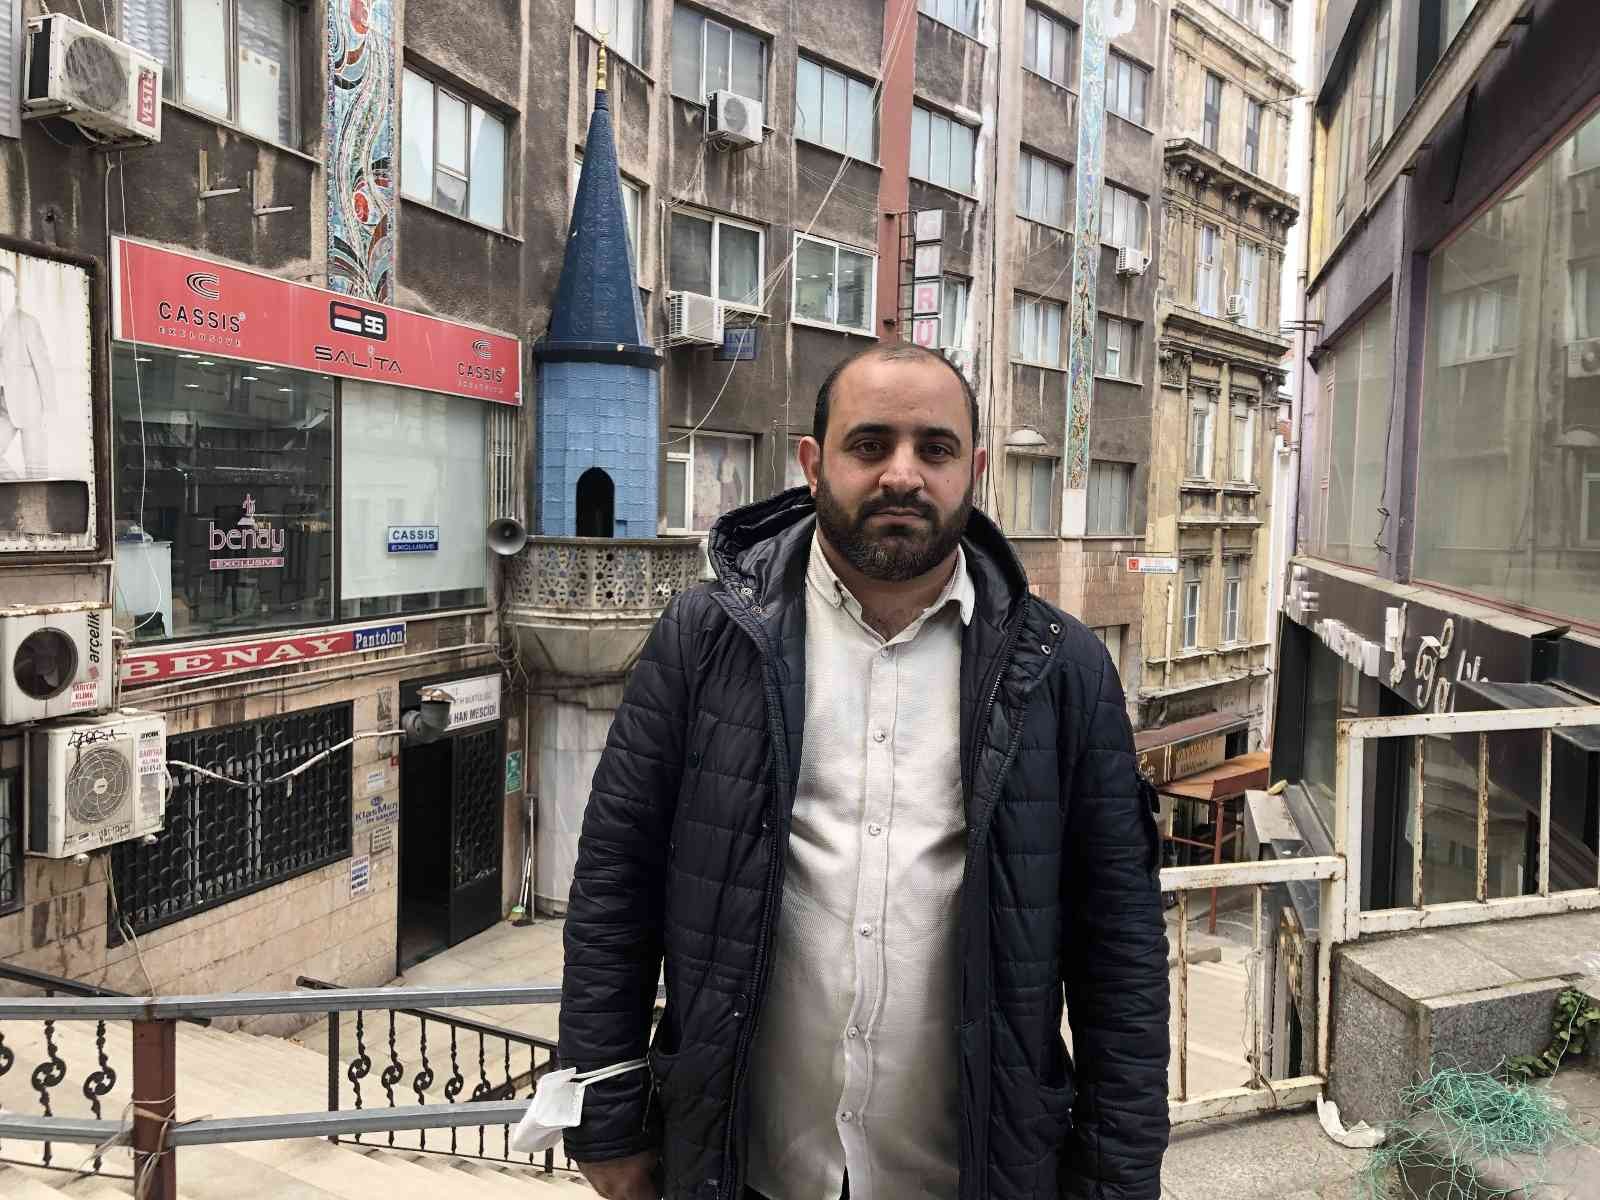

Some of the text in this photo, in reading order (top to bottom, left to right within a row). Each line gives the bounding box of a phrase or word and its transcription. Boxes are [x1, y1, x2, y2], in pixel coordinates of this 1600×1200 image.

[158, 301, 241, 333] CASSIS
[457, 362, 503, 383] CASSIS
[392, 530, 435, 540] CASSIS
[87, 611, 103, 664] arçelik
[121, 626, 405, 679] BENAY Pantolon
